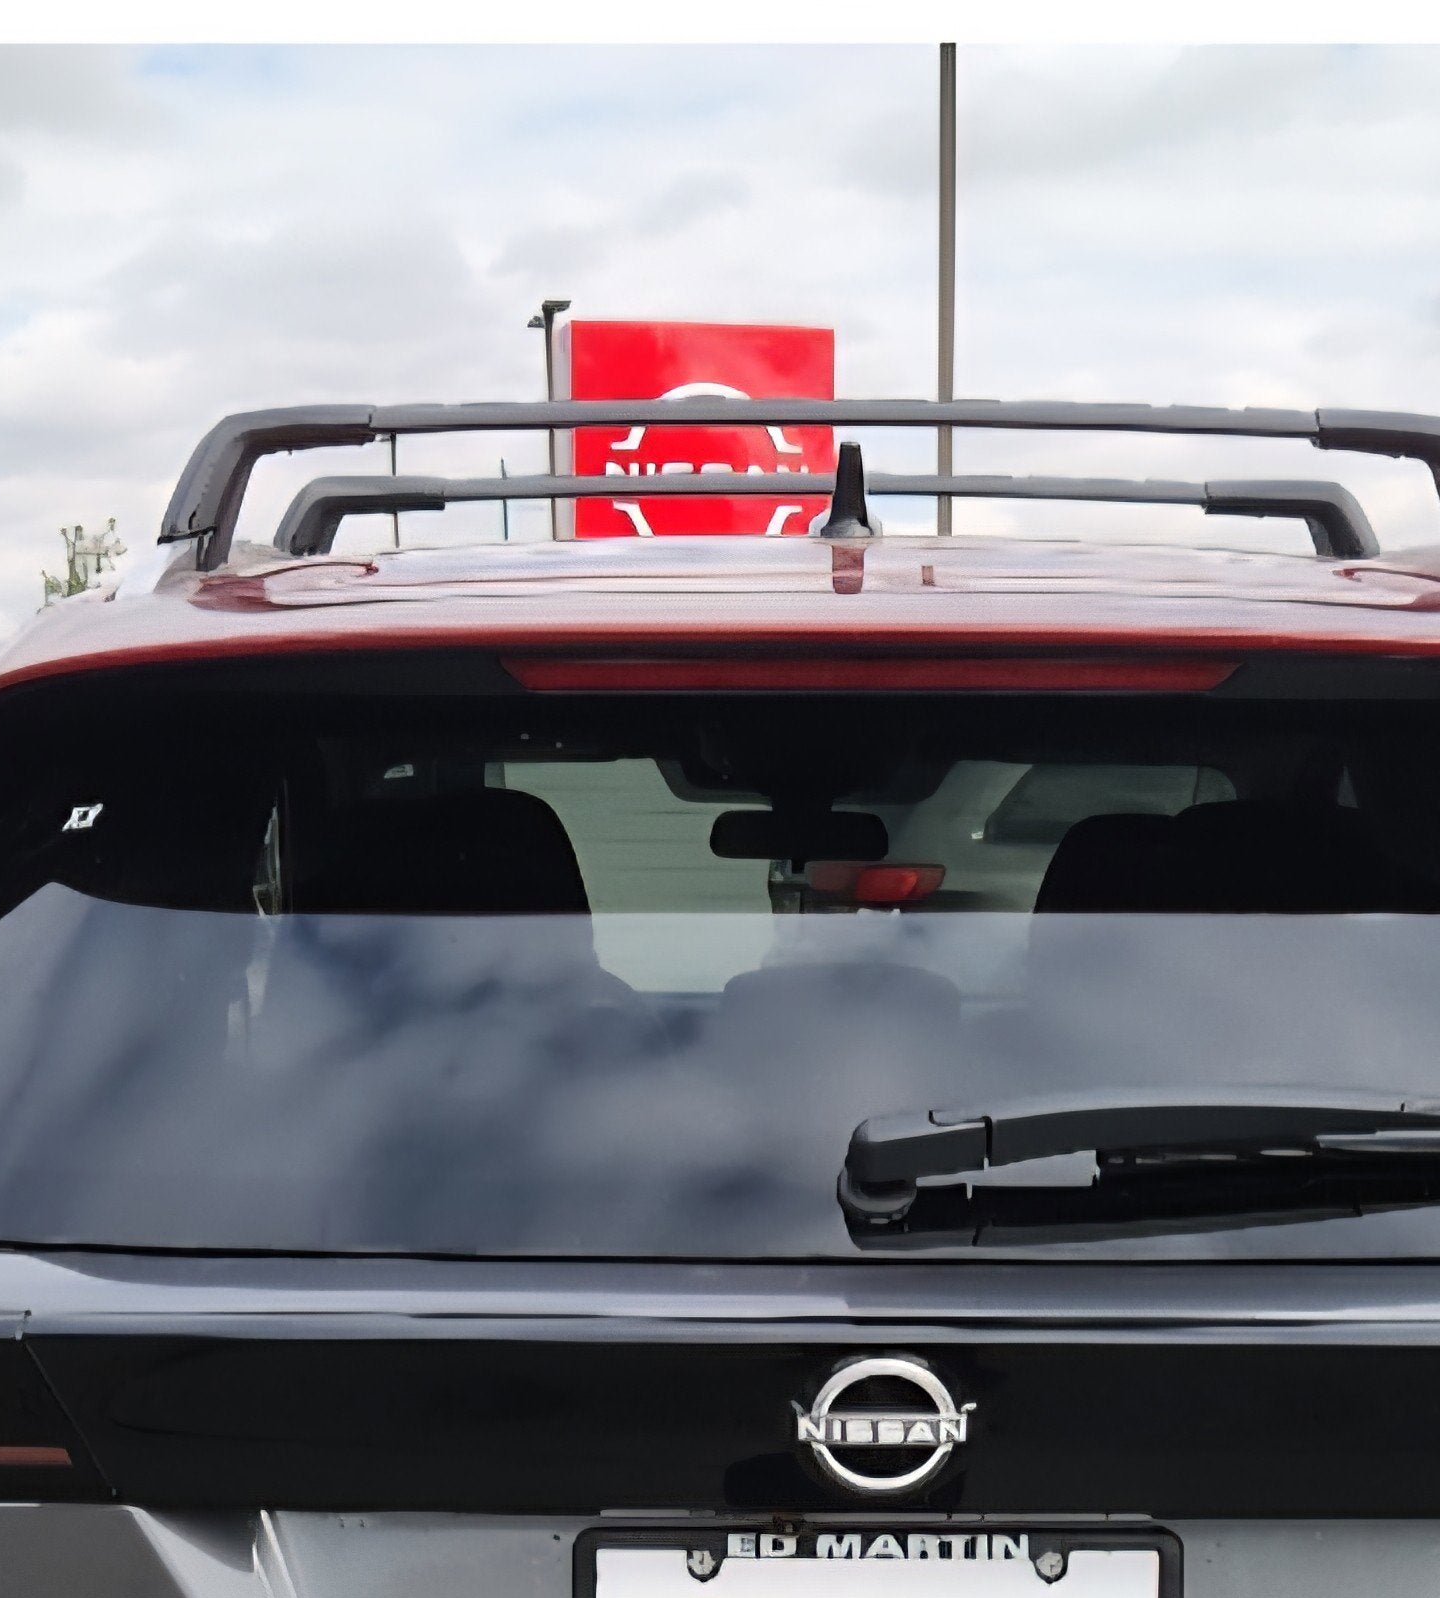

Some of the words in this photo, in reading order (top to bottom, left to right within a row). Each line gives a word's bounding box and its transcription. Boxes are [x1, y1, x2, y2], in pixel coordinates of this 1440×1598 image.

[796, 1411, 968, 1443] NISSAN
[726, 1533, 797, 1558] ED
[816, 1533, 1030, 1560] MARTIN
